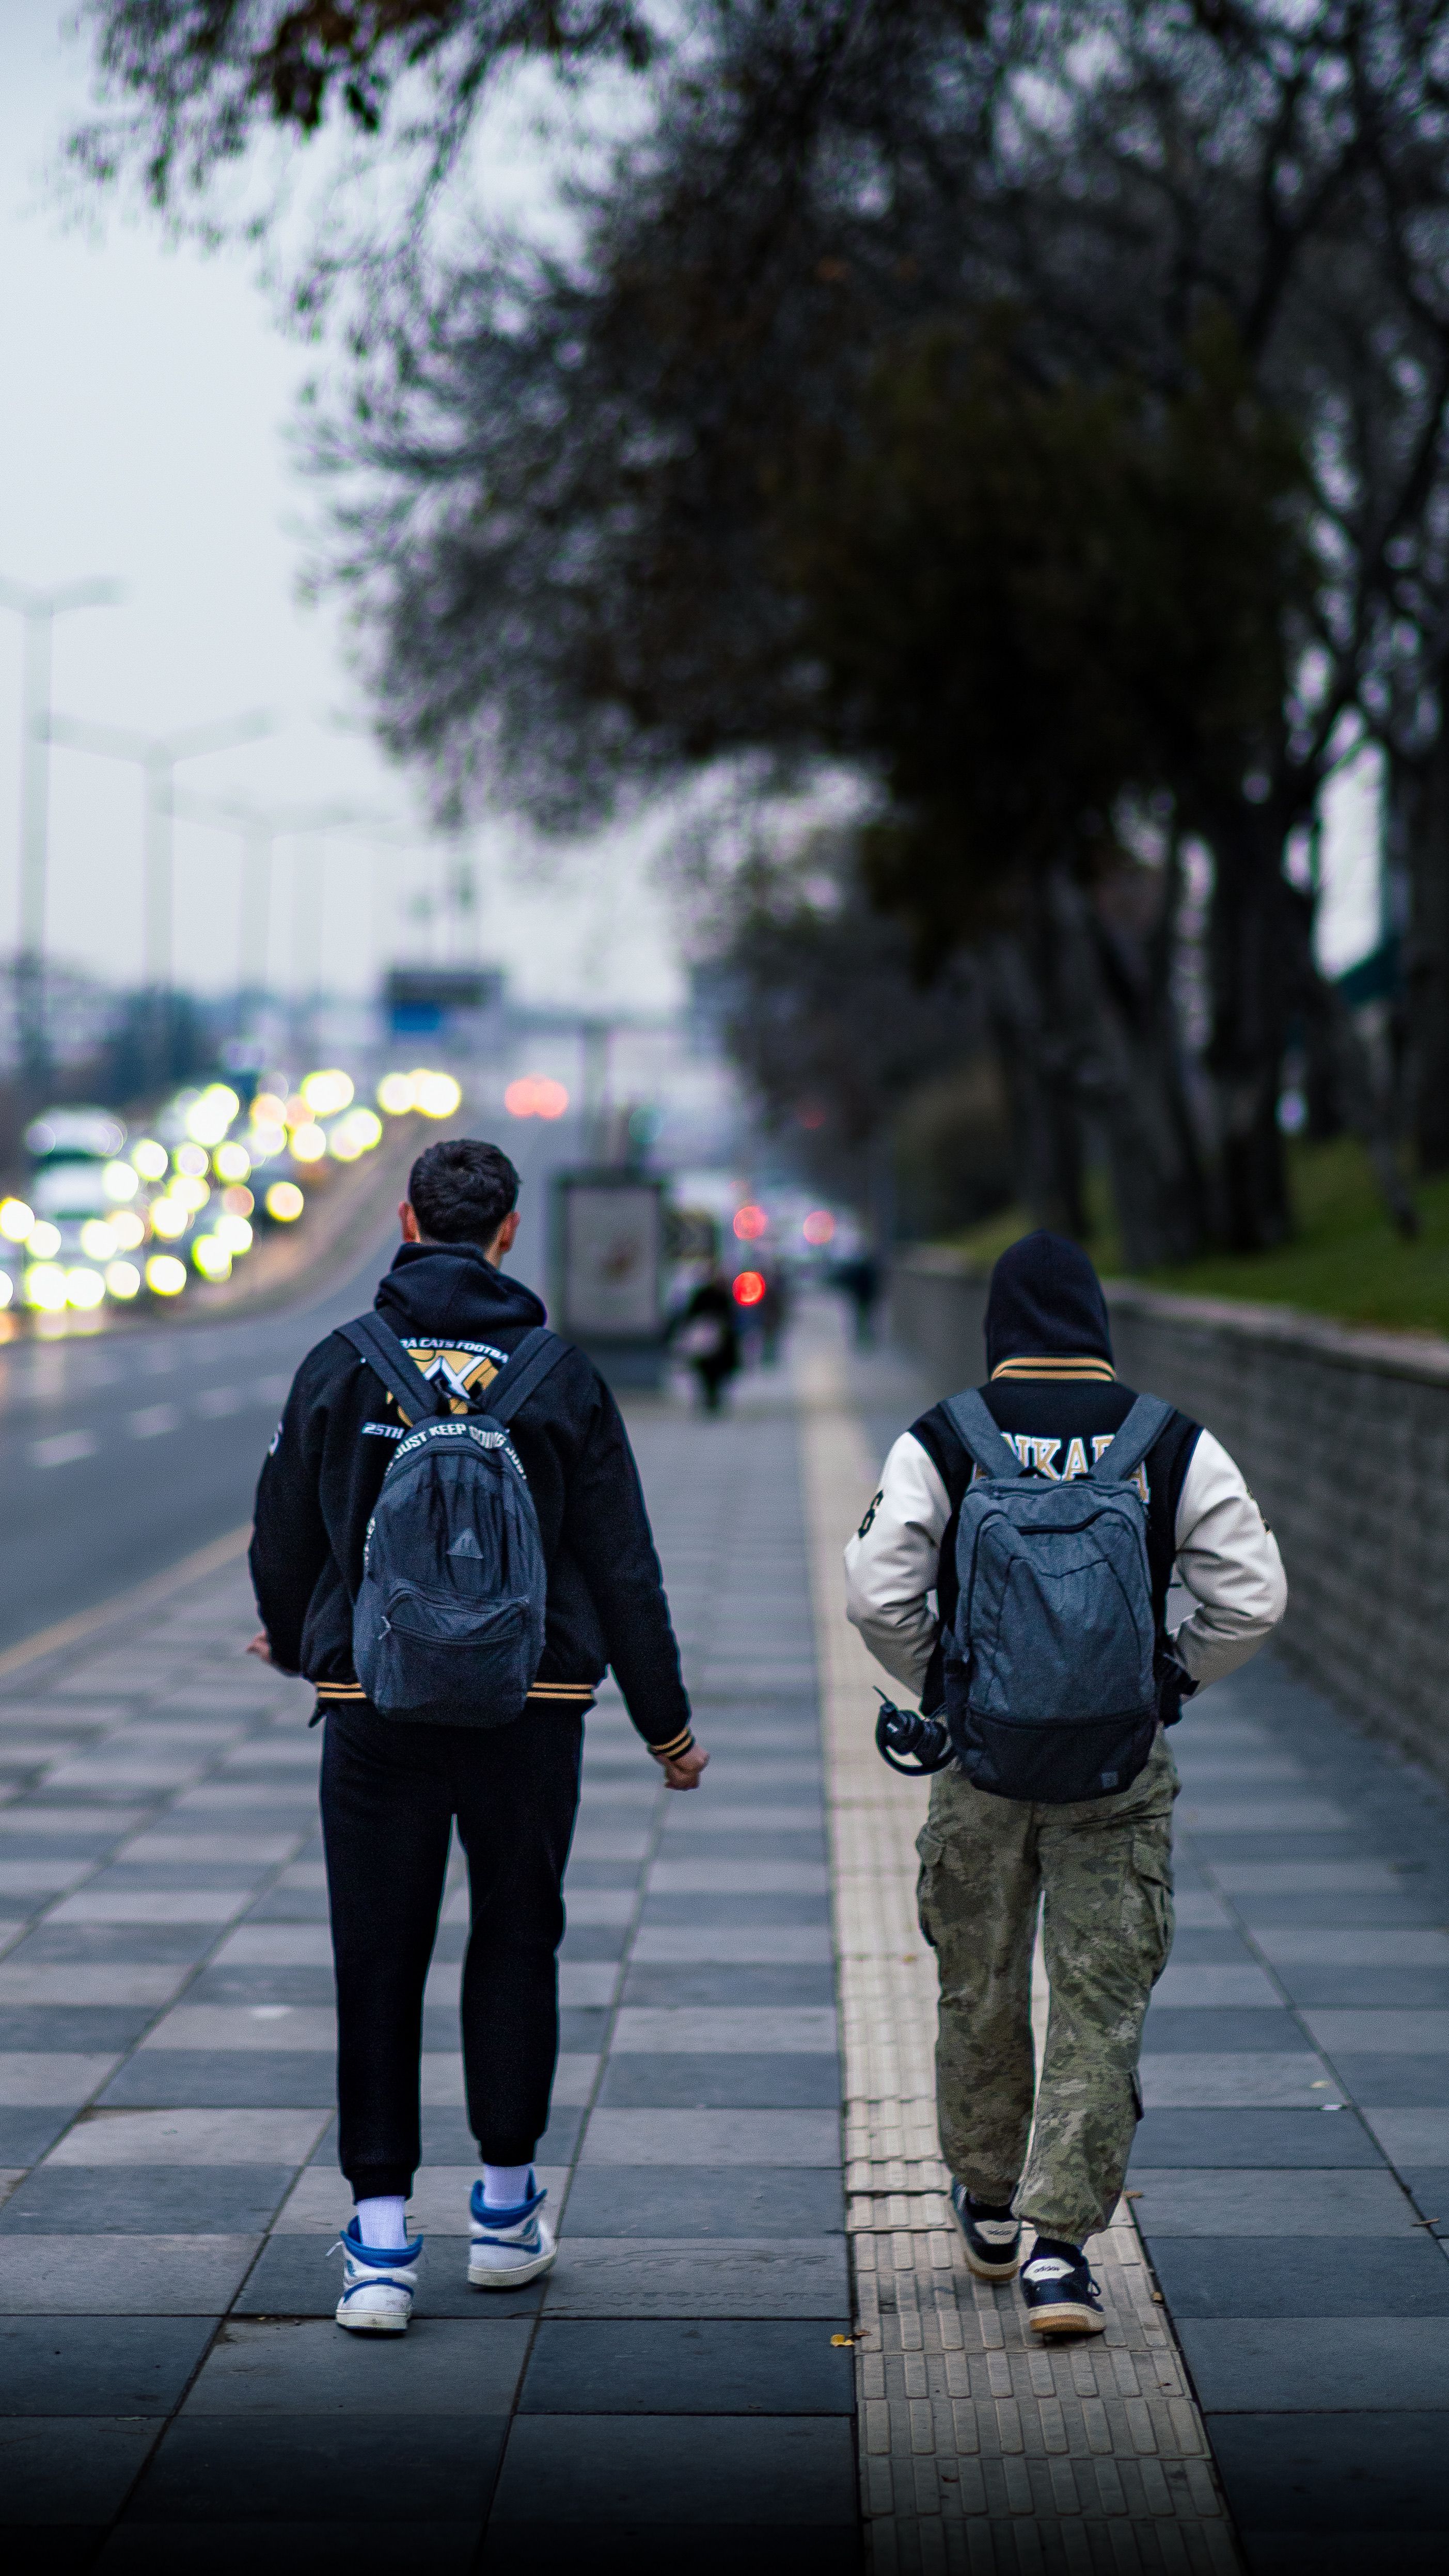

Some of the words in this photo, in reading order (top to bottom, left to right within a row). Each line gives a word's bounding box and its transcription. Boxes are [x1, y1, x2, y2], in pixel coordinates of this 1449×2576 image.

[419, 1338, 455, 1348] CATS
[362, 1422, 404, 1439] 25TH
[395, 1431, 427, 1459] JUST
[429, 1423, 466, 1436] KEEP
